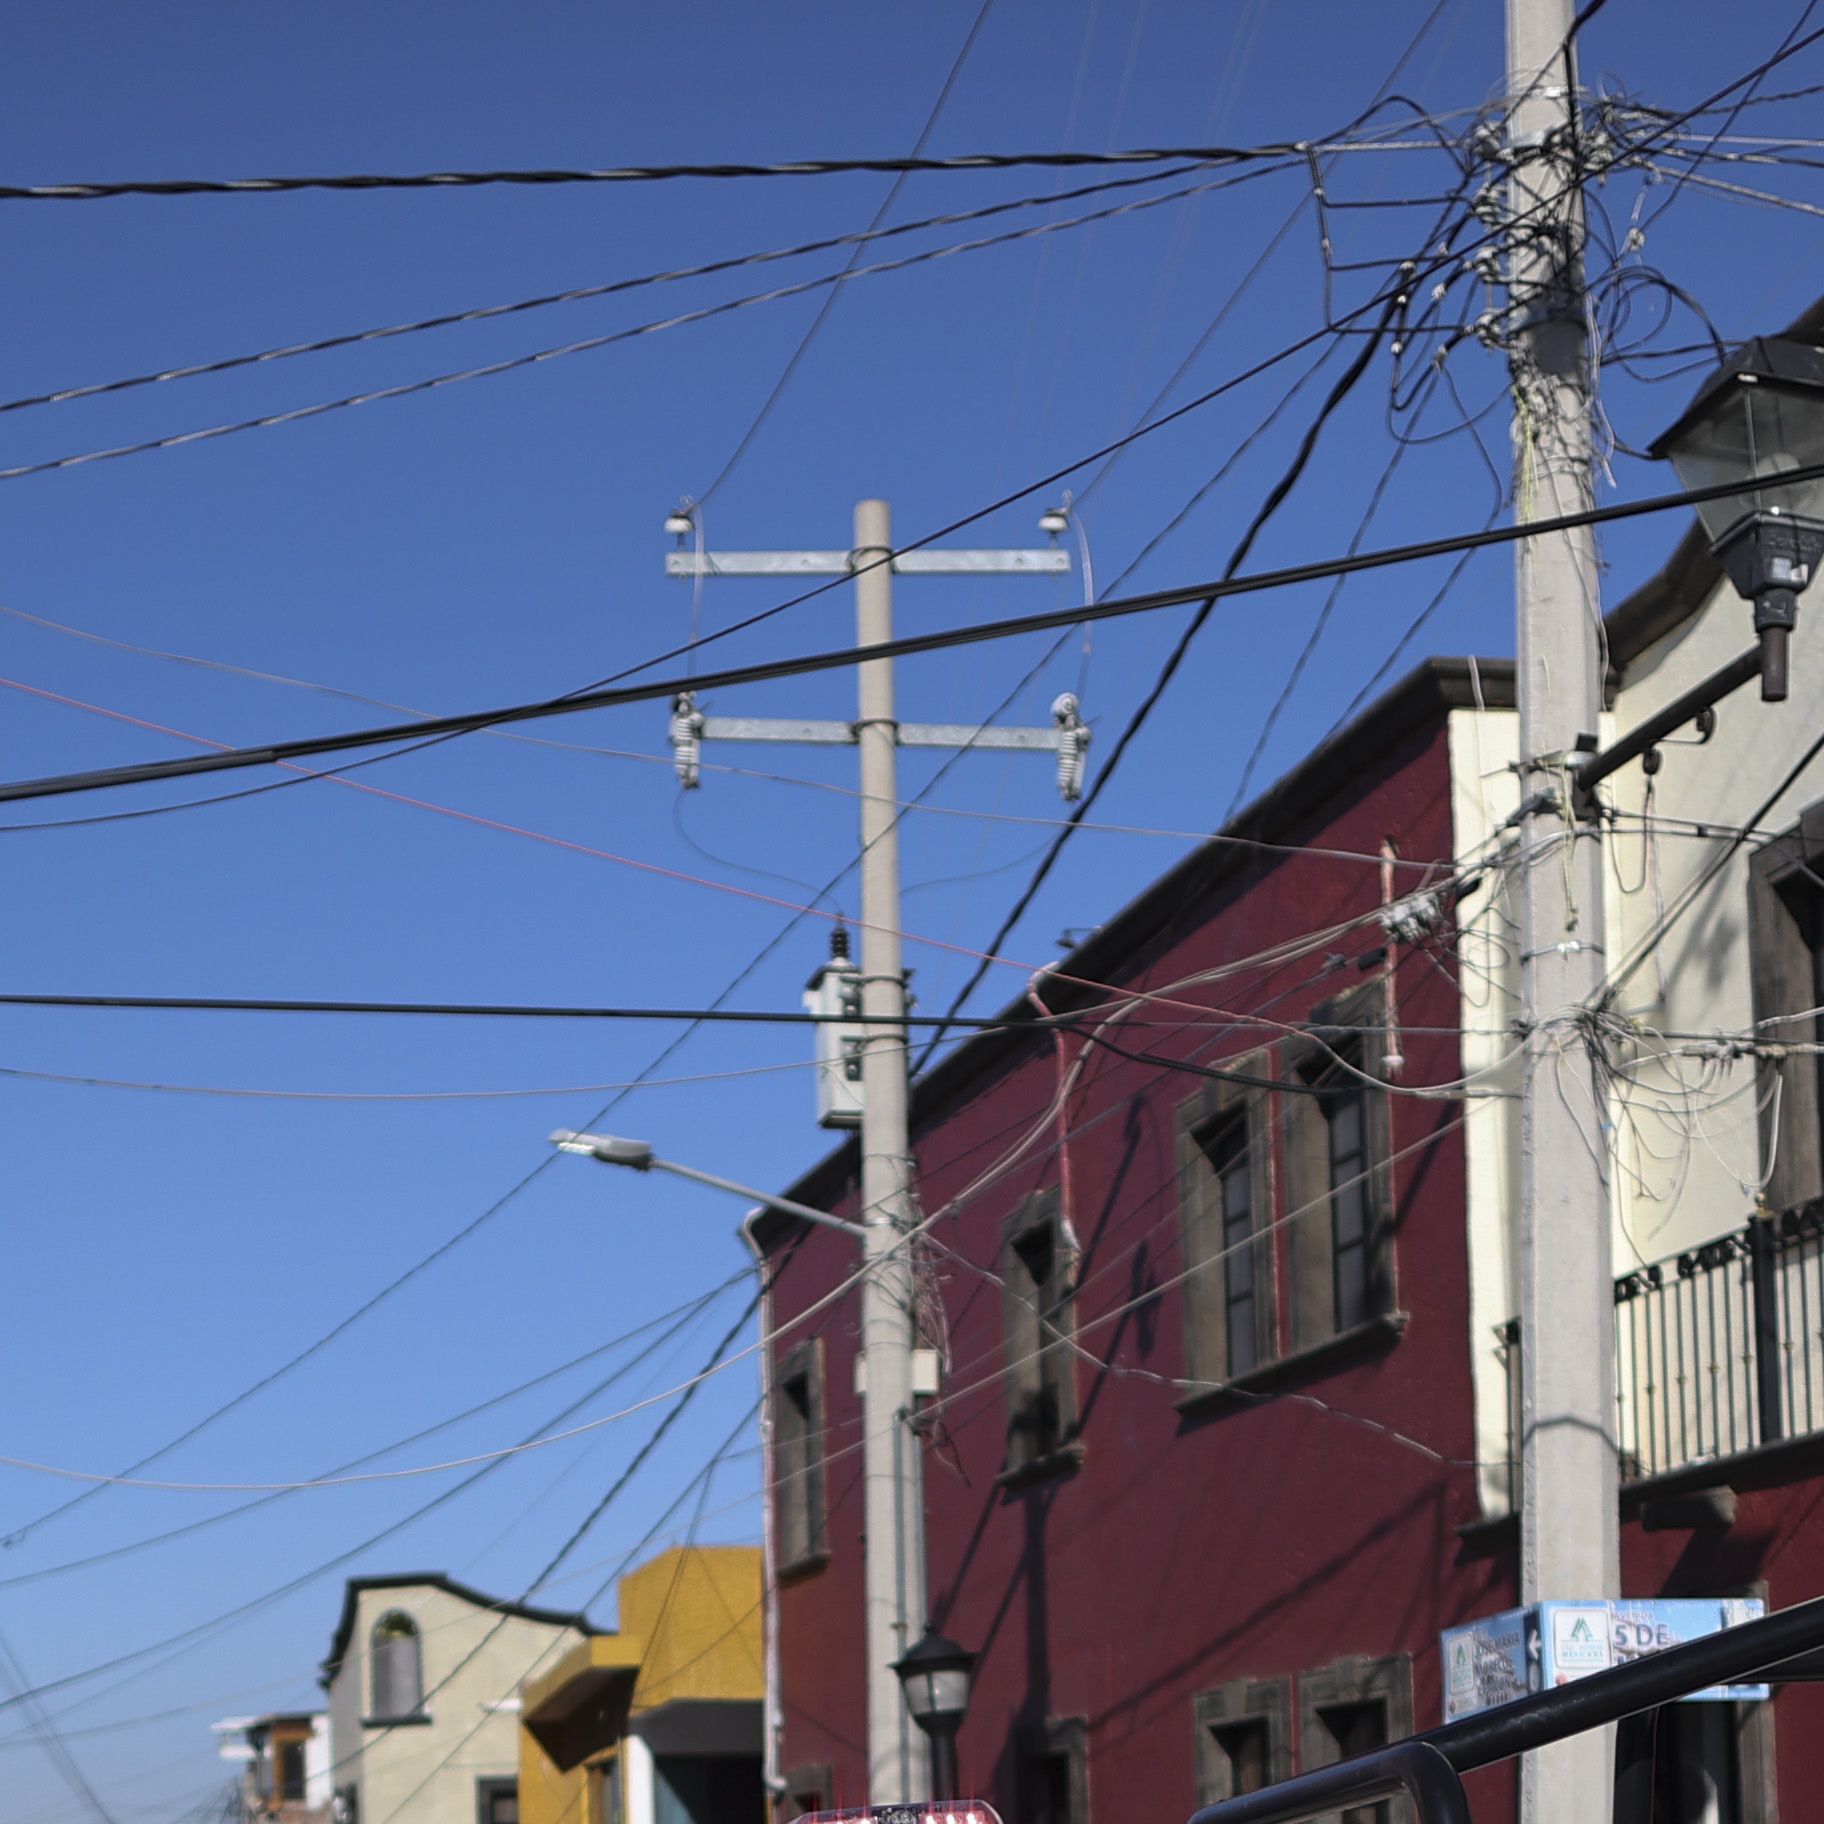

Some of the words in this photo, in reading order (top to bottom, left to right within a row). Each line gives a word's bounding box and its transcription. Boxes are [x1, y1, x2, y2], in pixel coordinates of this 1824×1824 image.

[1613, 1611, 1654, 1620] AVENIDA
[1615, 1624, 1629, 1647] 5
[1635, 1623, 1669, 1647] DE
